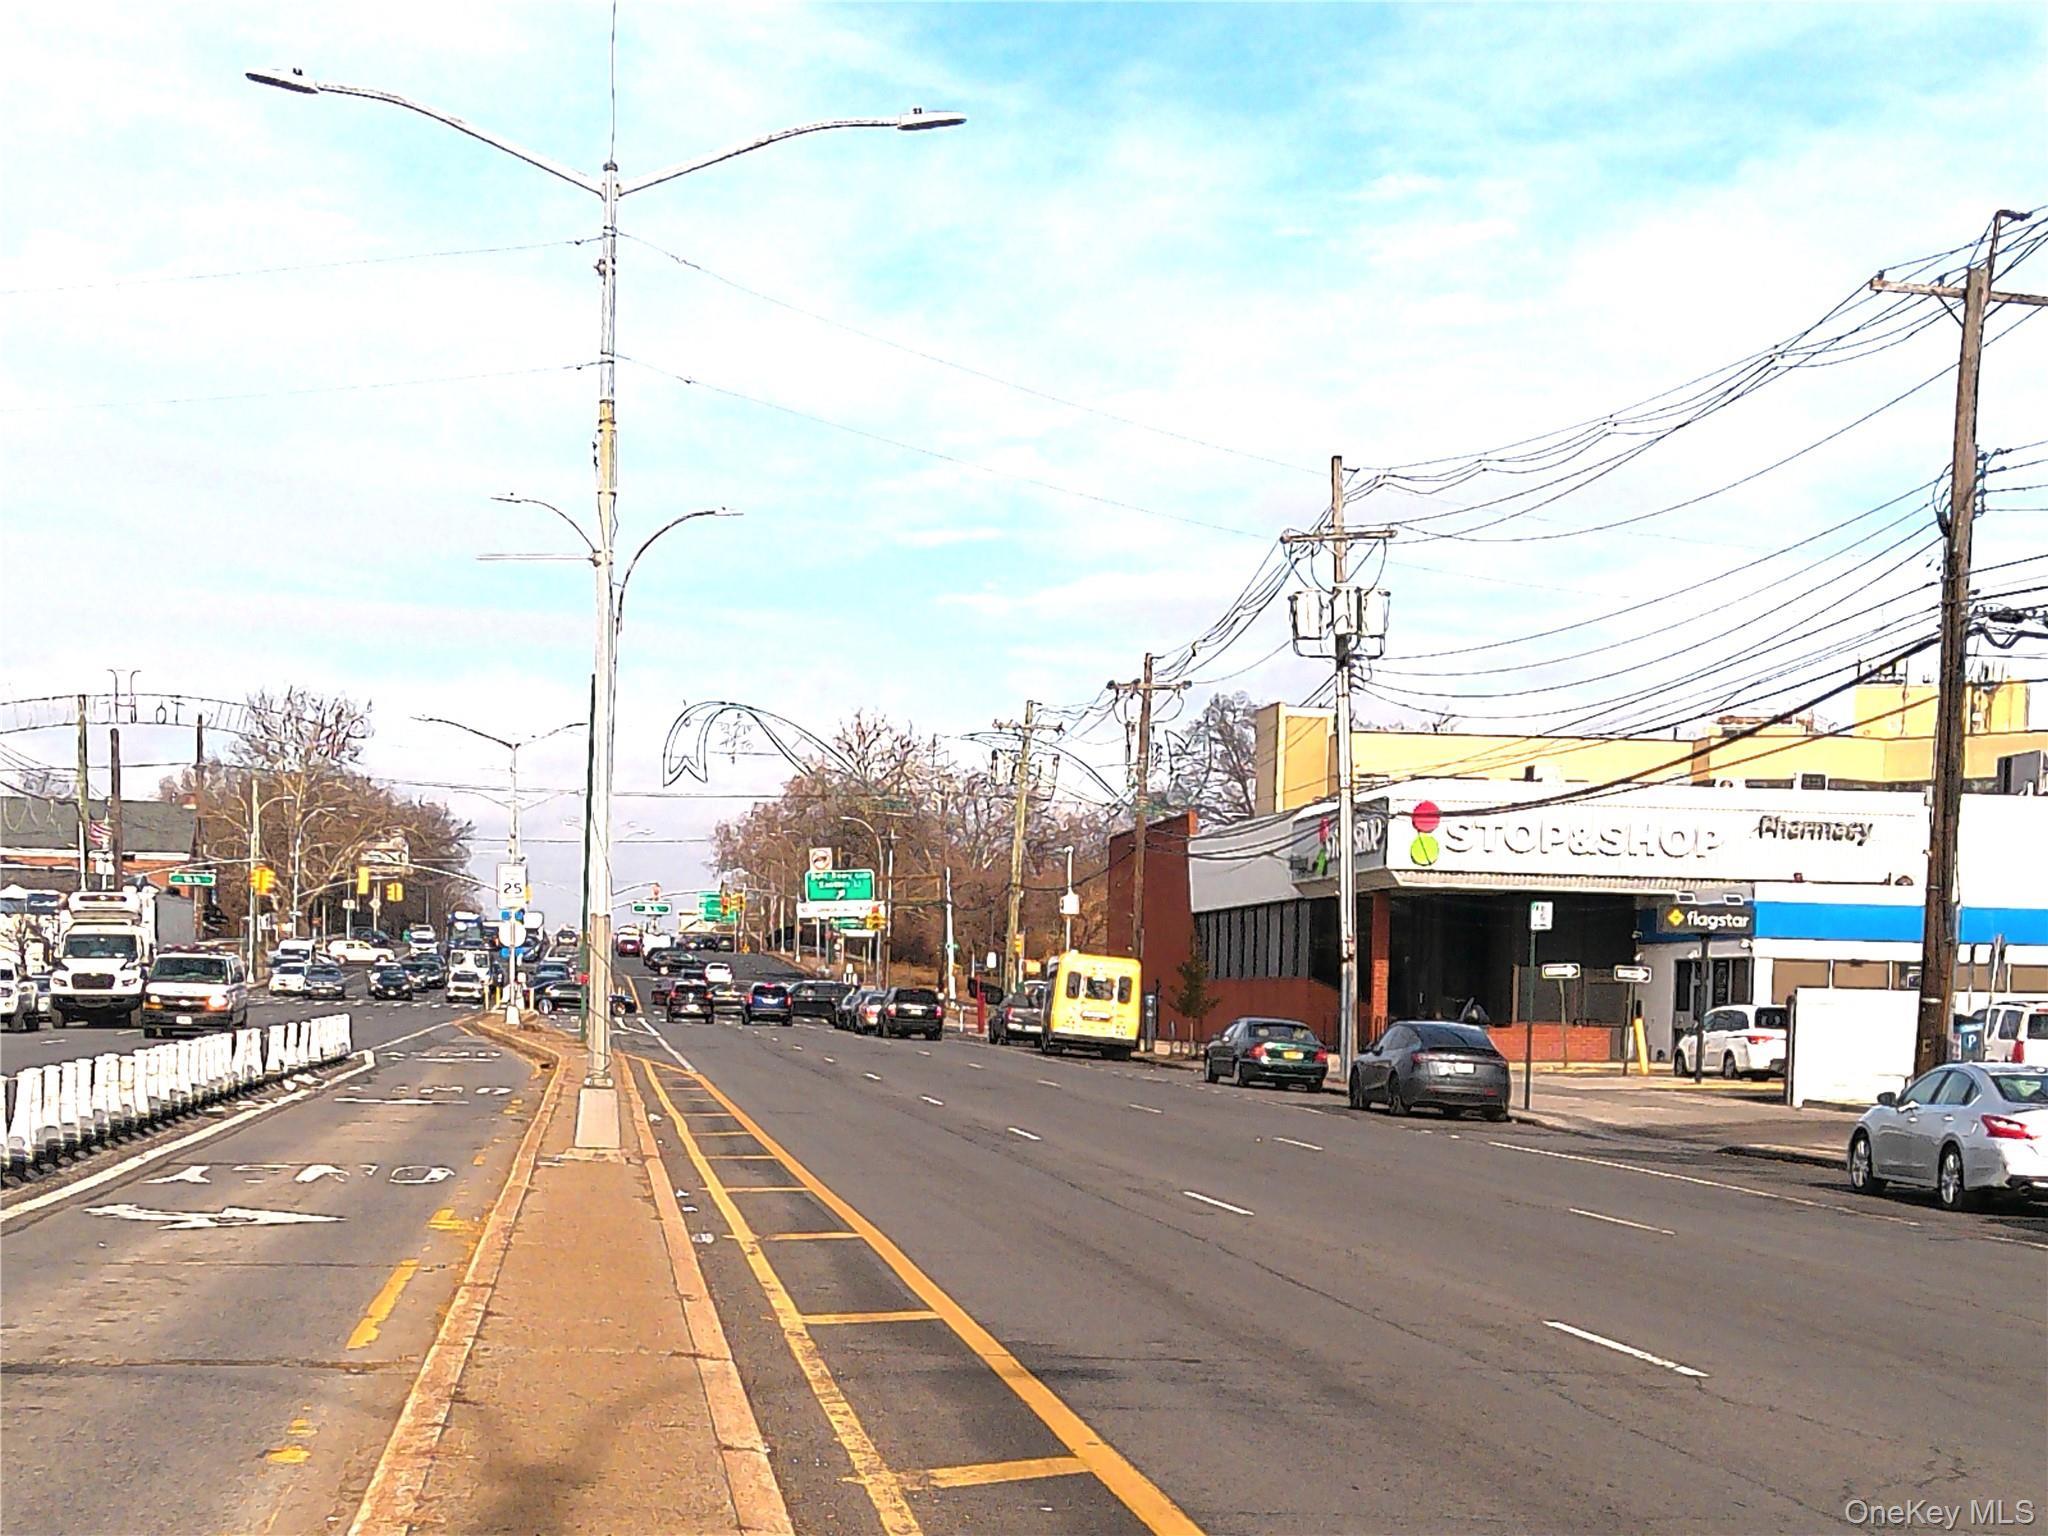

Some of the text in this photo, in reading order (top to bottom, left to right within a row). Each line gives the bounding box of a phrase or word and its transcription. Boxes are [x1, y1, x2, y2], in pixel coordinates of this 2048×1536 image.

[1445, 820, 1725, 858] STOP&SHOP
[503, 882, 523, 894] 25
[1686, 909, 1750, 931] flagstar
